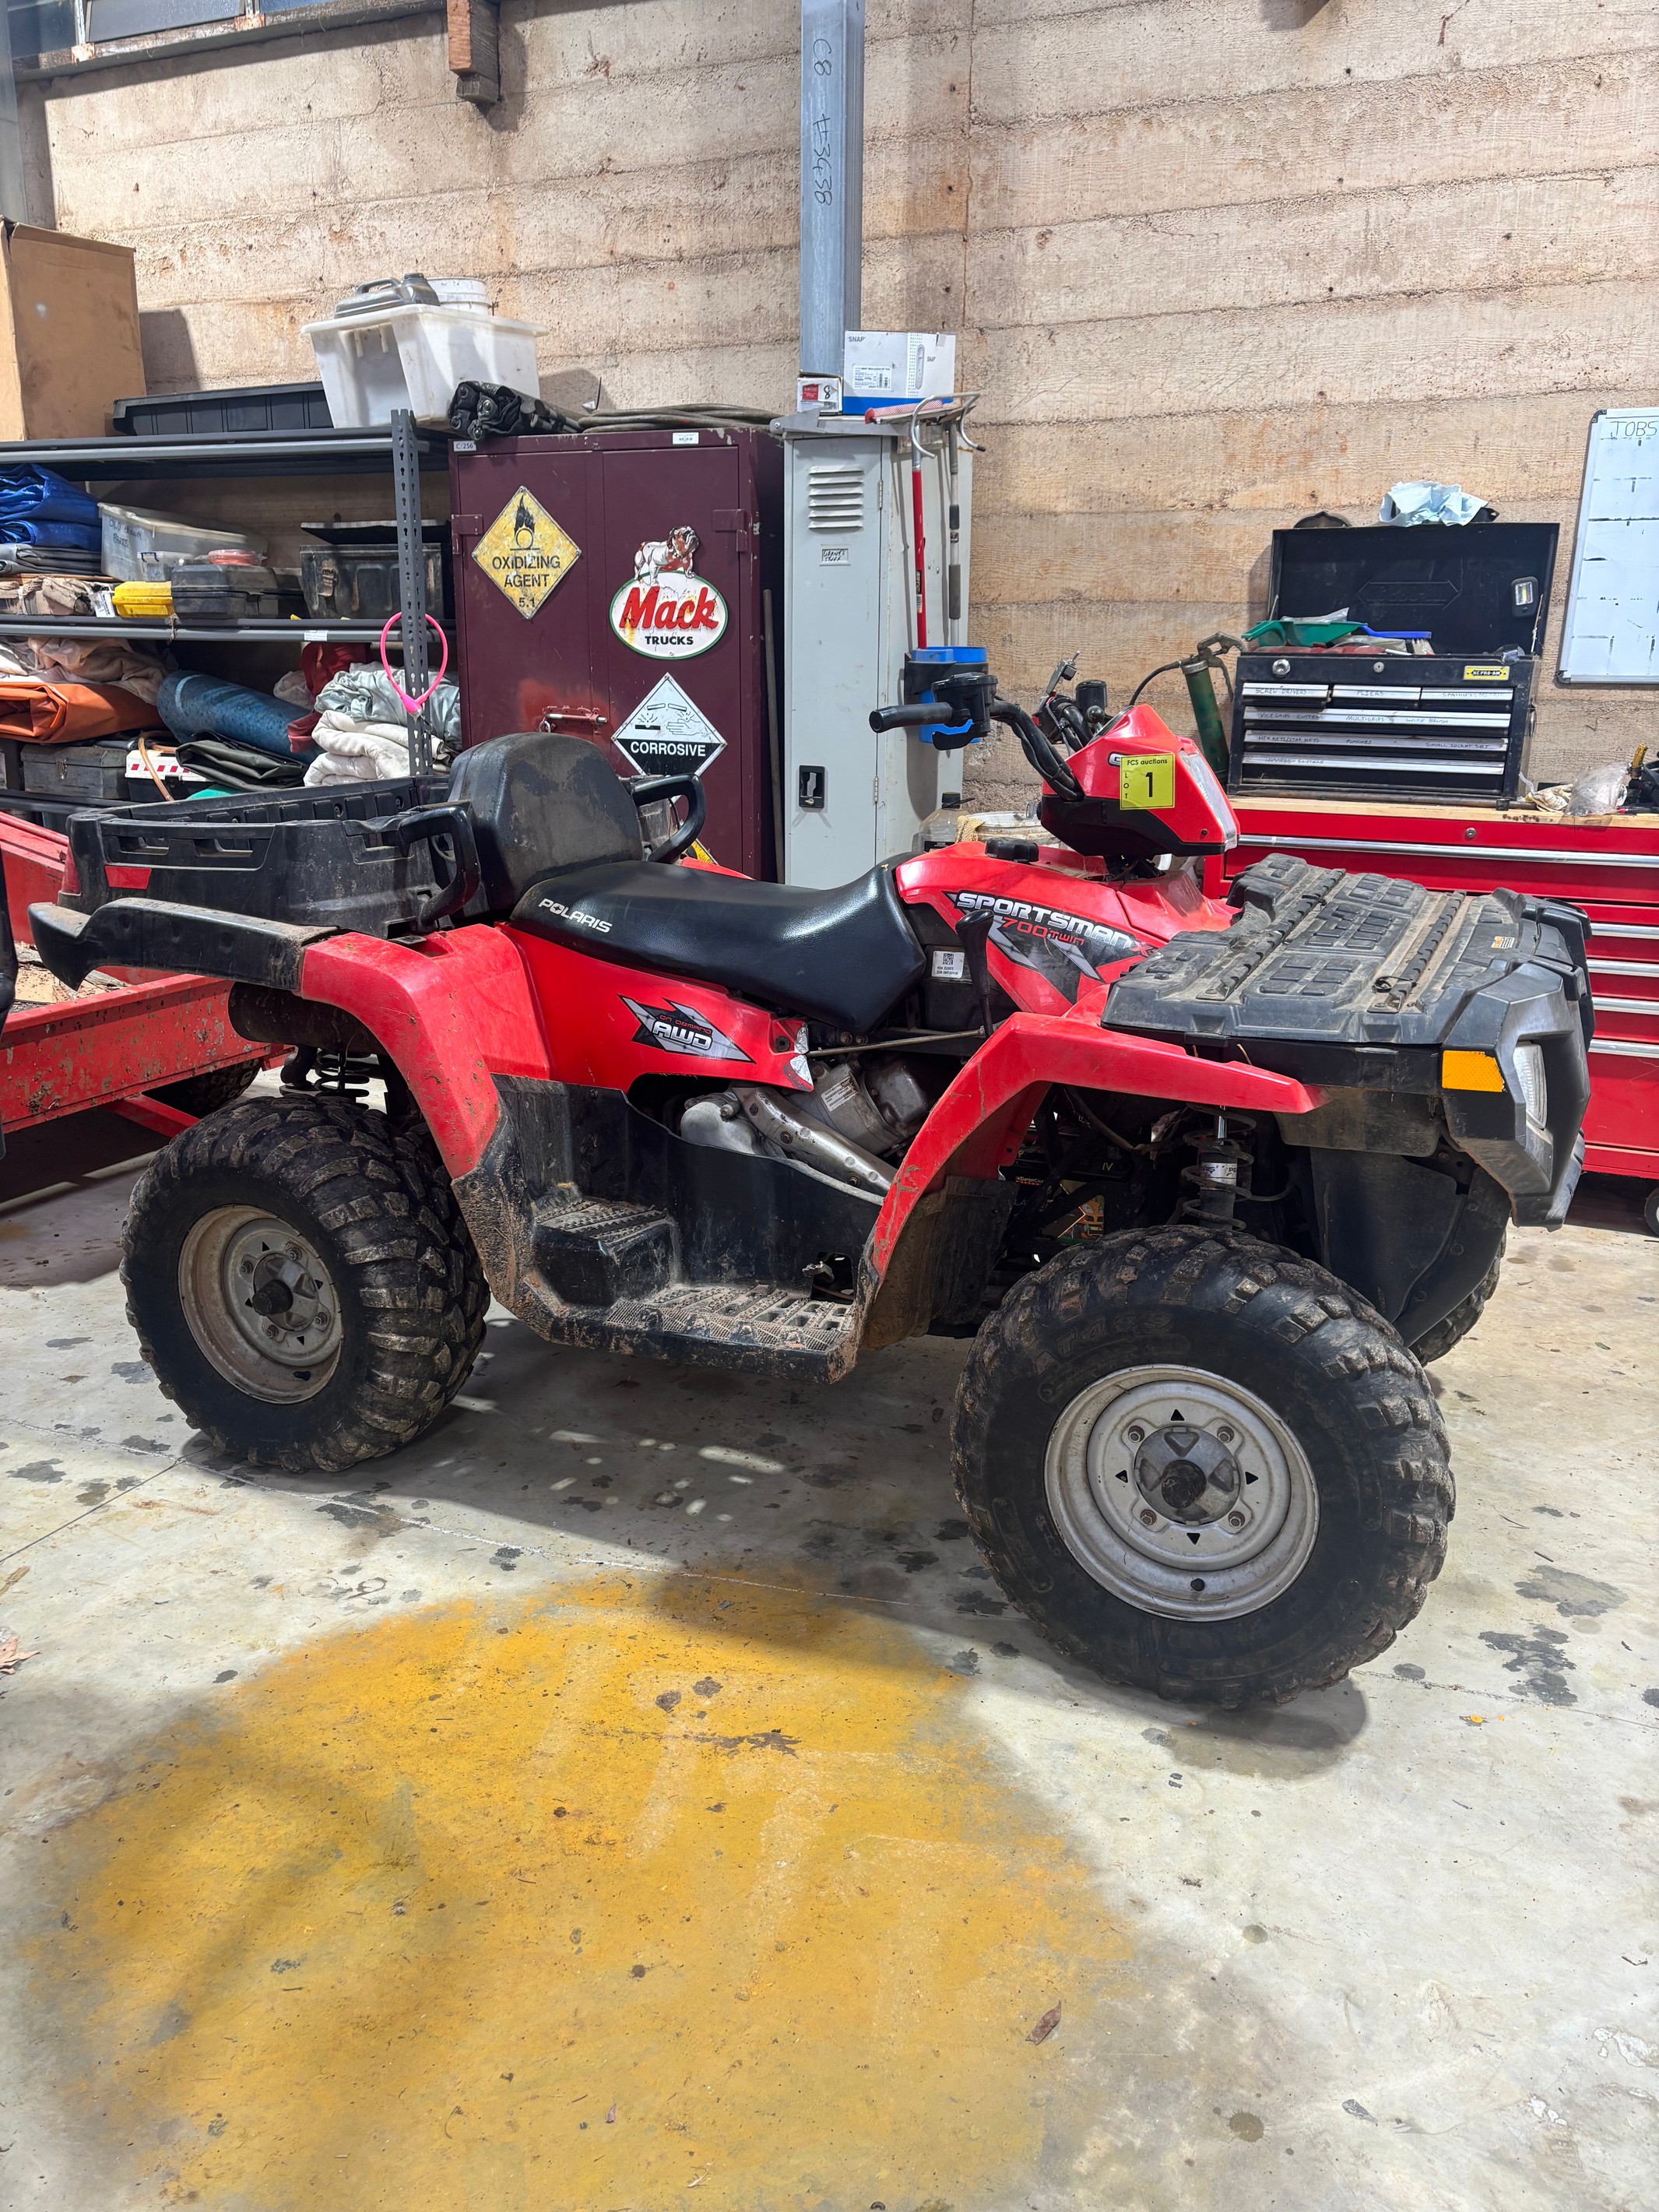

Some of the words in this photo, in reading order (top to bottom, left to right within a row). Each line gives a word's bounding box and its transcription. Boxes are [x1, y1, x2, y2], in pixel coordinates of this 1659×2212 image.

[1609, 420, 1657, 438] JOBS
[492, 555, 561, 569] OXIDIZING
[504, 574, 550, 587] AGENT
[518, 597, 536, 607] 5.1
[619, 586, 719, 629] Mack
[645, 635, 694, 645] TRUCKS
[630, 741, 706, 757] CORROSIVE
[1145, 772, 1153, 797] 1
[538, 898, 613, 933] POLARIS
[957, 892, 1133, 950] SPORTSMAN
[1002, 916, 1049, 938] 700
[652, 1021, 712, 1050] AWD
[676, 1019, 712, 1035] DEMAND
